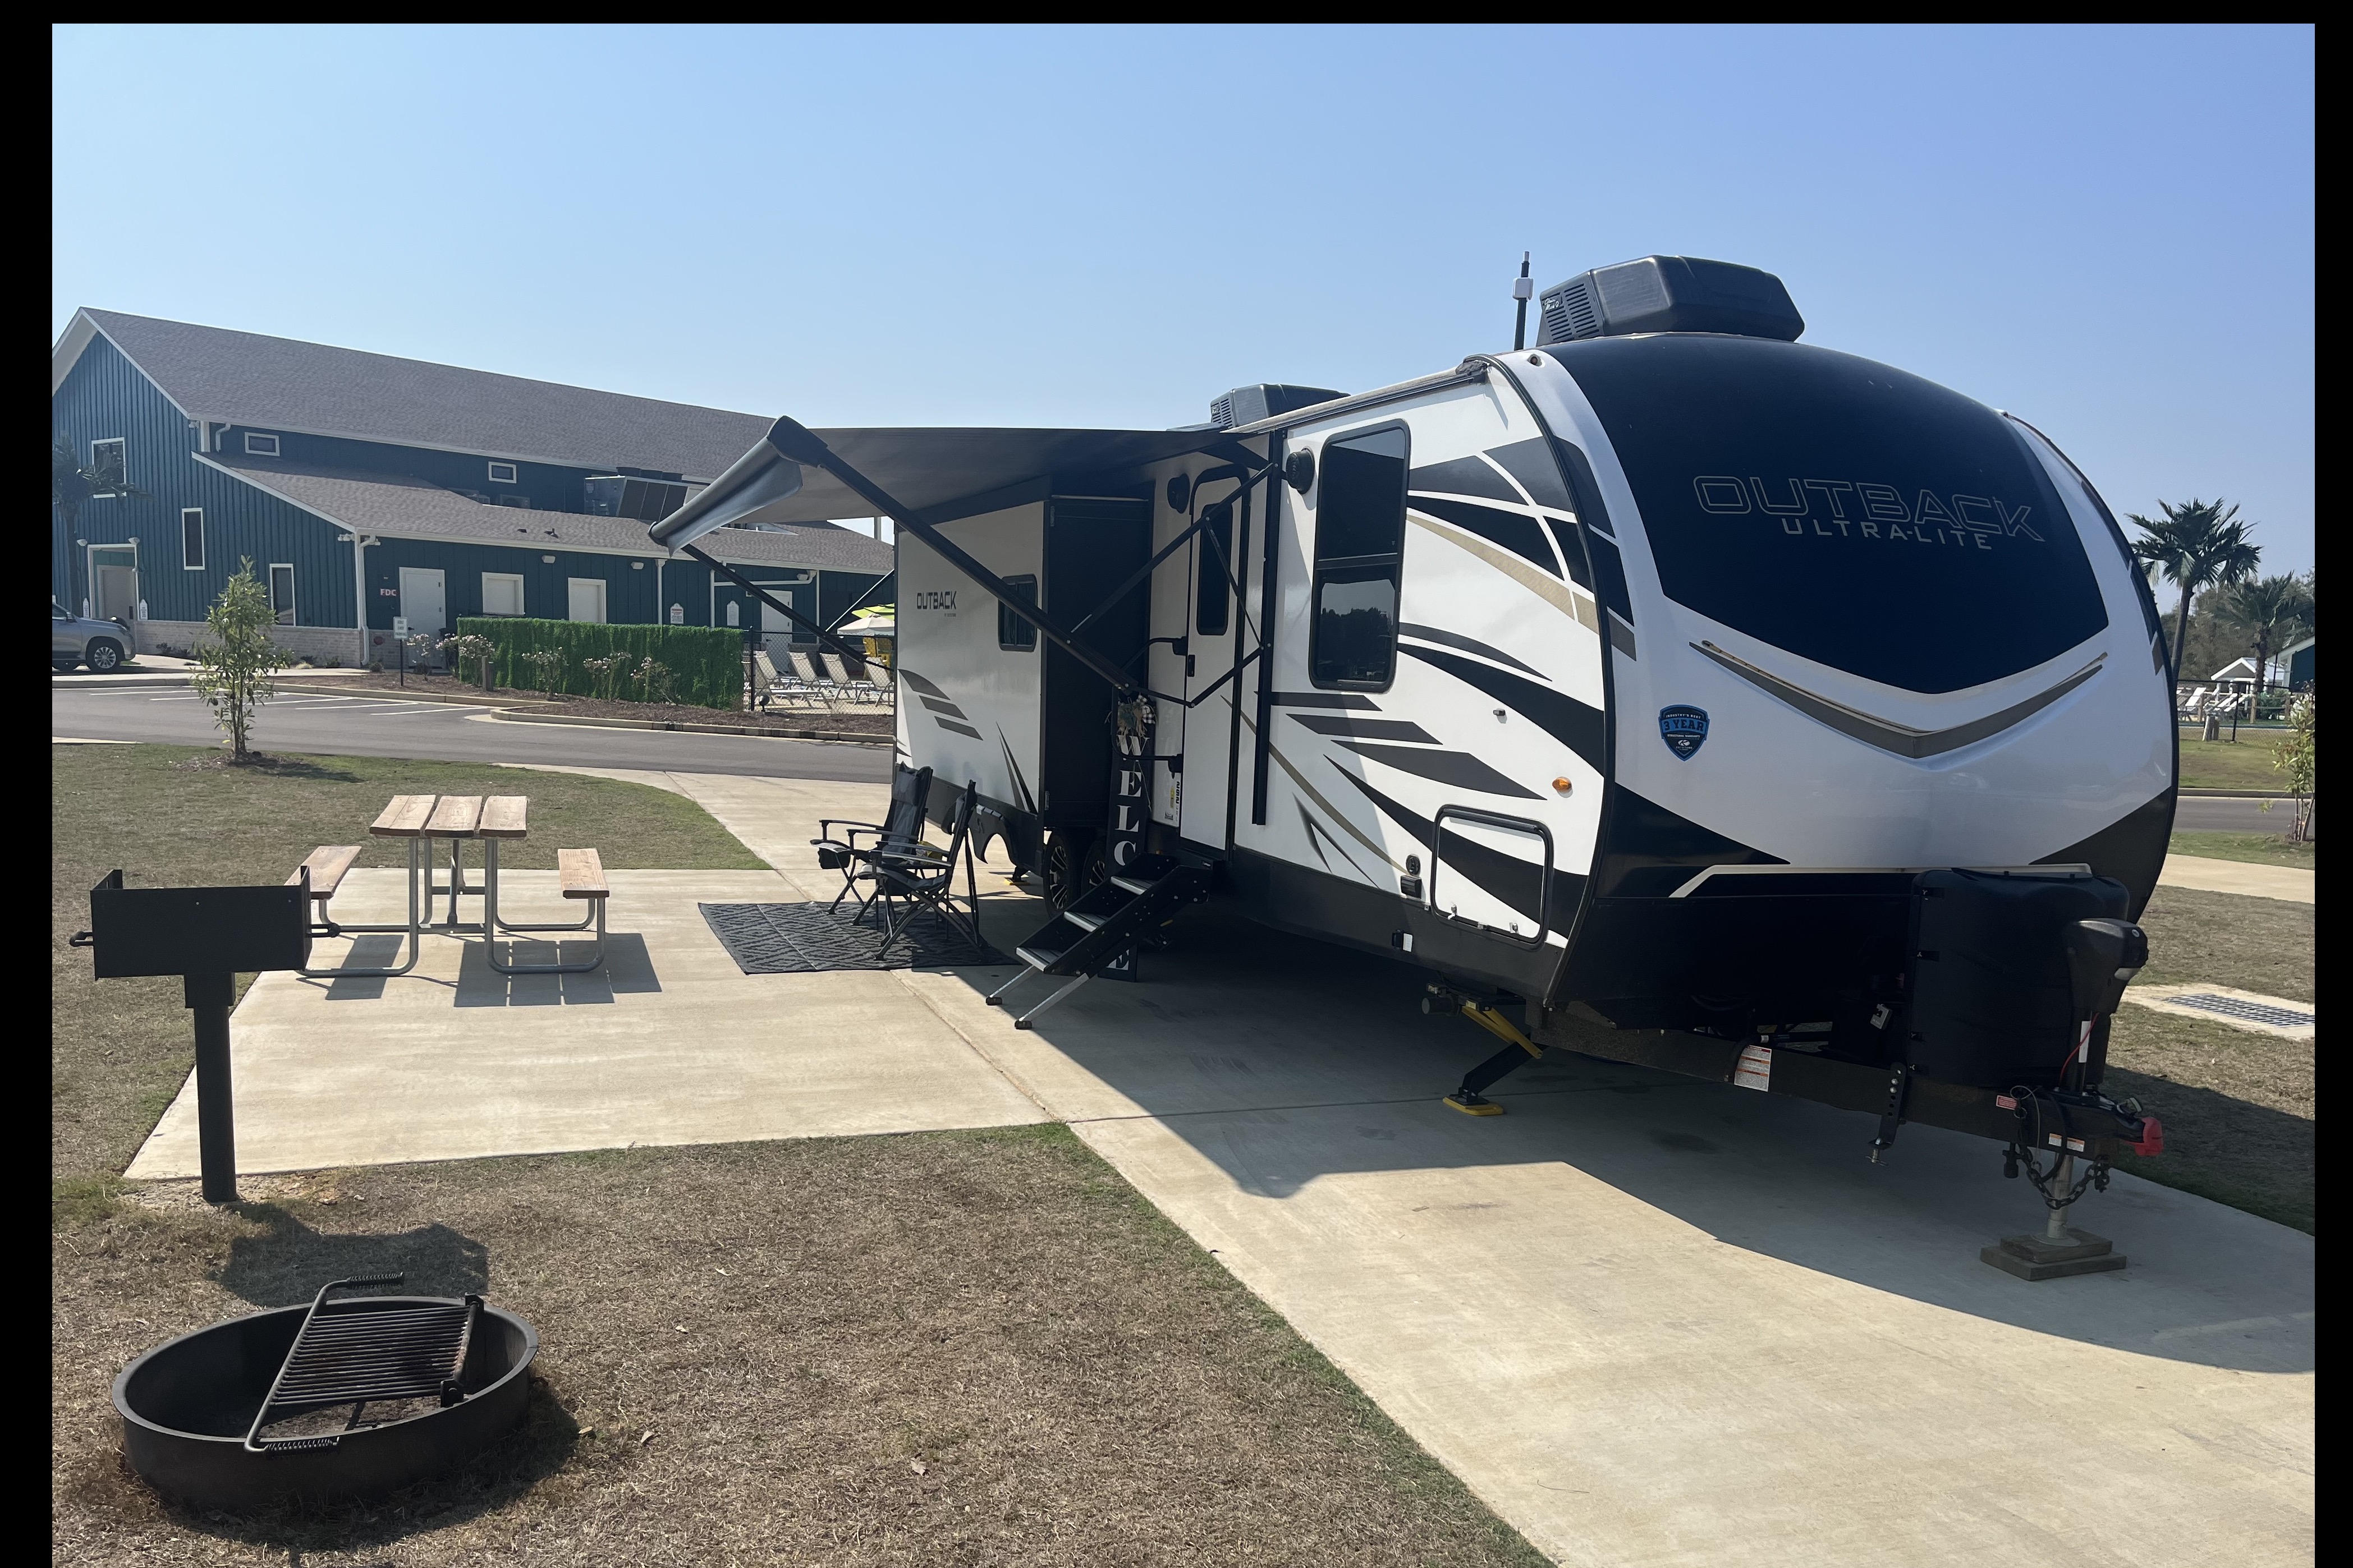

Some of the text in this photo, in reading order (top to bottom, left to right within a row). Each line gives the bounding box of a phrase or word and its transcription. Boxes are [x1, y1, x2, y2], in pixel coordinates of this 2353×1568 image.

[1693, 476, 2045, 542] OUTBACK
[917, 591, 957, 609] OUTBACK
[1664, 719, 1704, 732] 3 YEAR
[1106, 734, 1150, 971] WELCE
